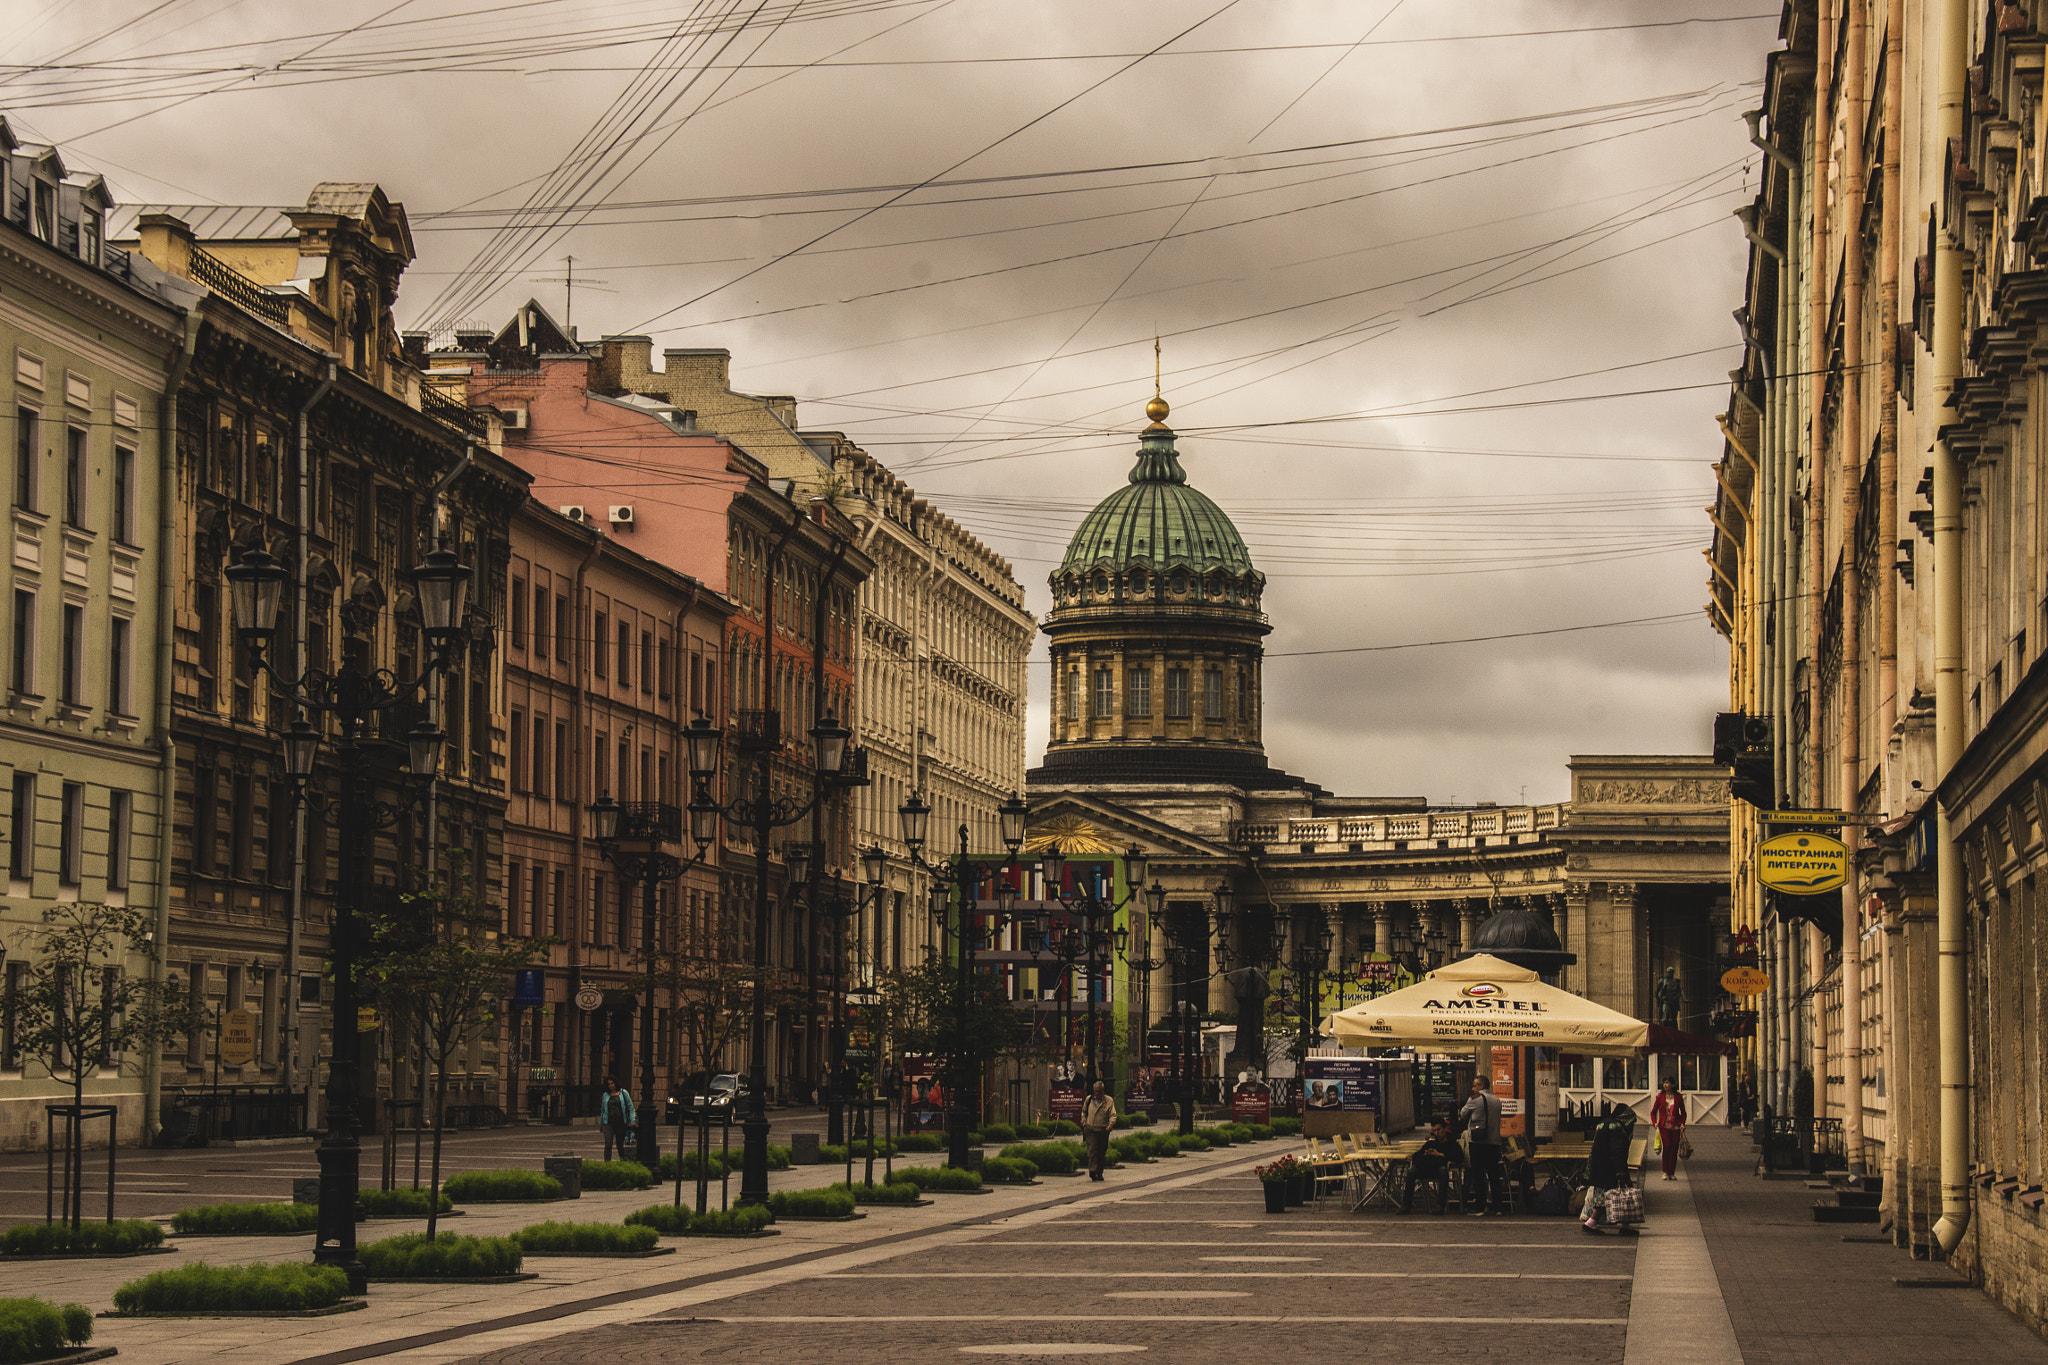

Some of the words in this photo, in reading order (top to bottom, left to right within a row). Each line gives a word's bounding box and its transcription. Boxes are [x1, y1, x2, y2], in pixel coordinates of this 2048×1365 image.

[1762, 849, 1843, 859] ИНОСТРАННАЯ
[1767, 861, 1837, 870] ЛИТЕРАТУРА
[1726, 977, 1765, 985] KORONA
[1422, 998, 1547, 1012] AMSTEL
[1432, 1019, 1497, 1028] НАСЛАЖДАЯСЬ
[1498, 1021, 1540, 1030] ЖИЗНЬЮ,
[1432, 1028, 1461, 1036] ЗДЕСЬ
[1475, 1029, 1514, 1037] ТОРОПЯТ
[1515, 1030, 1544, 1038] ВРЕМЯ
[1540, 1078, 1549, 1086] 4G
